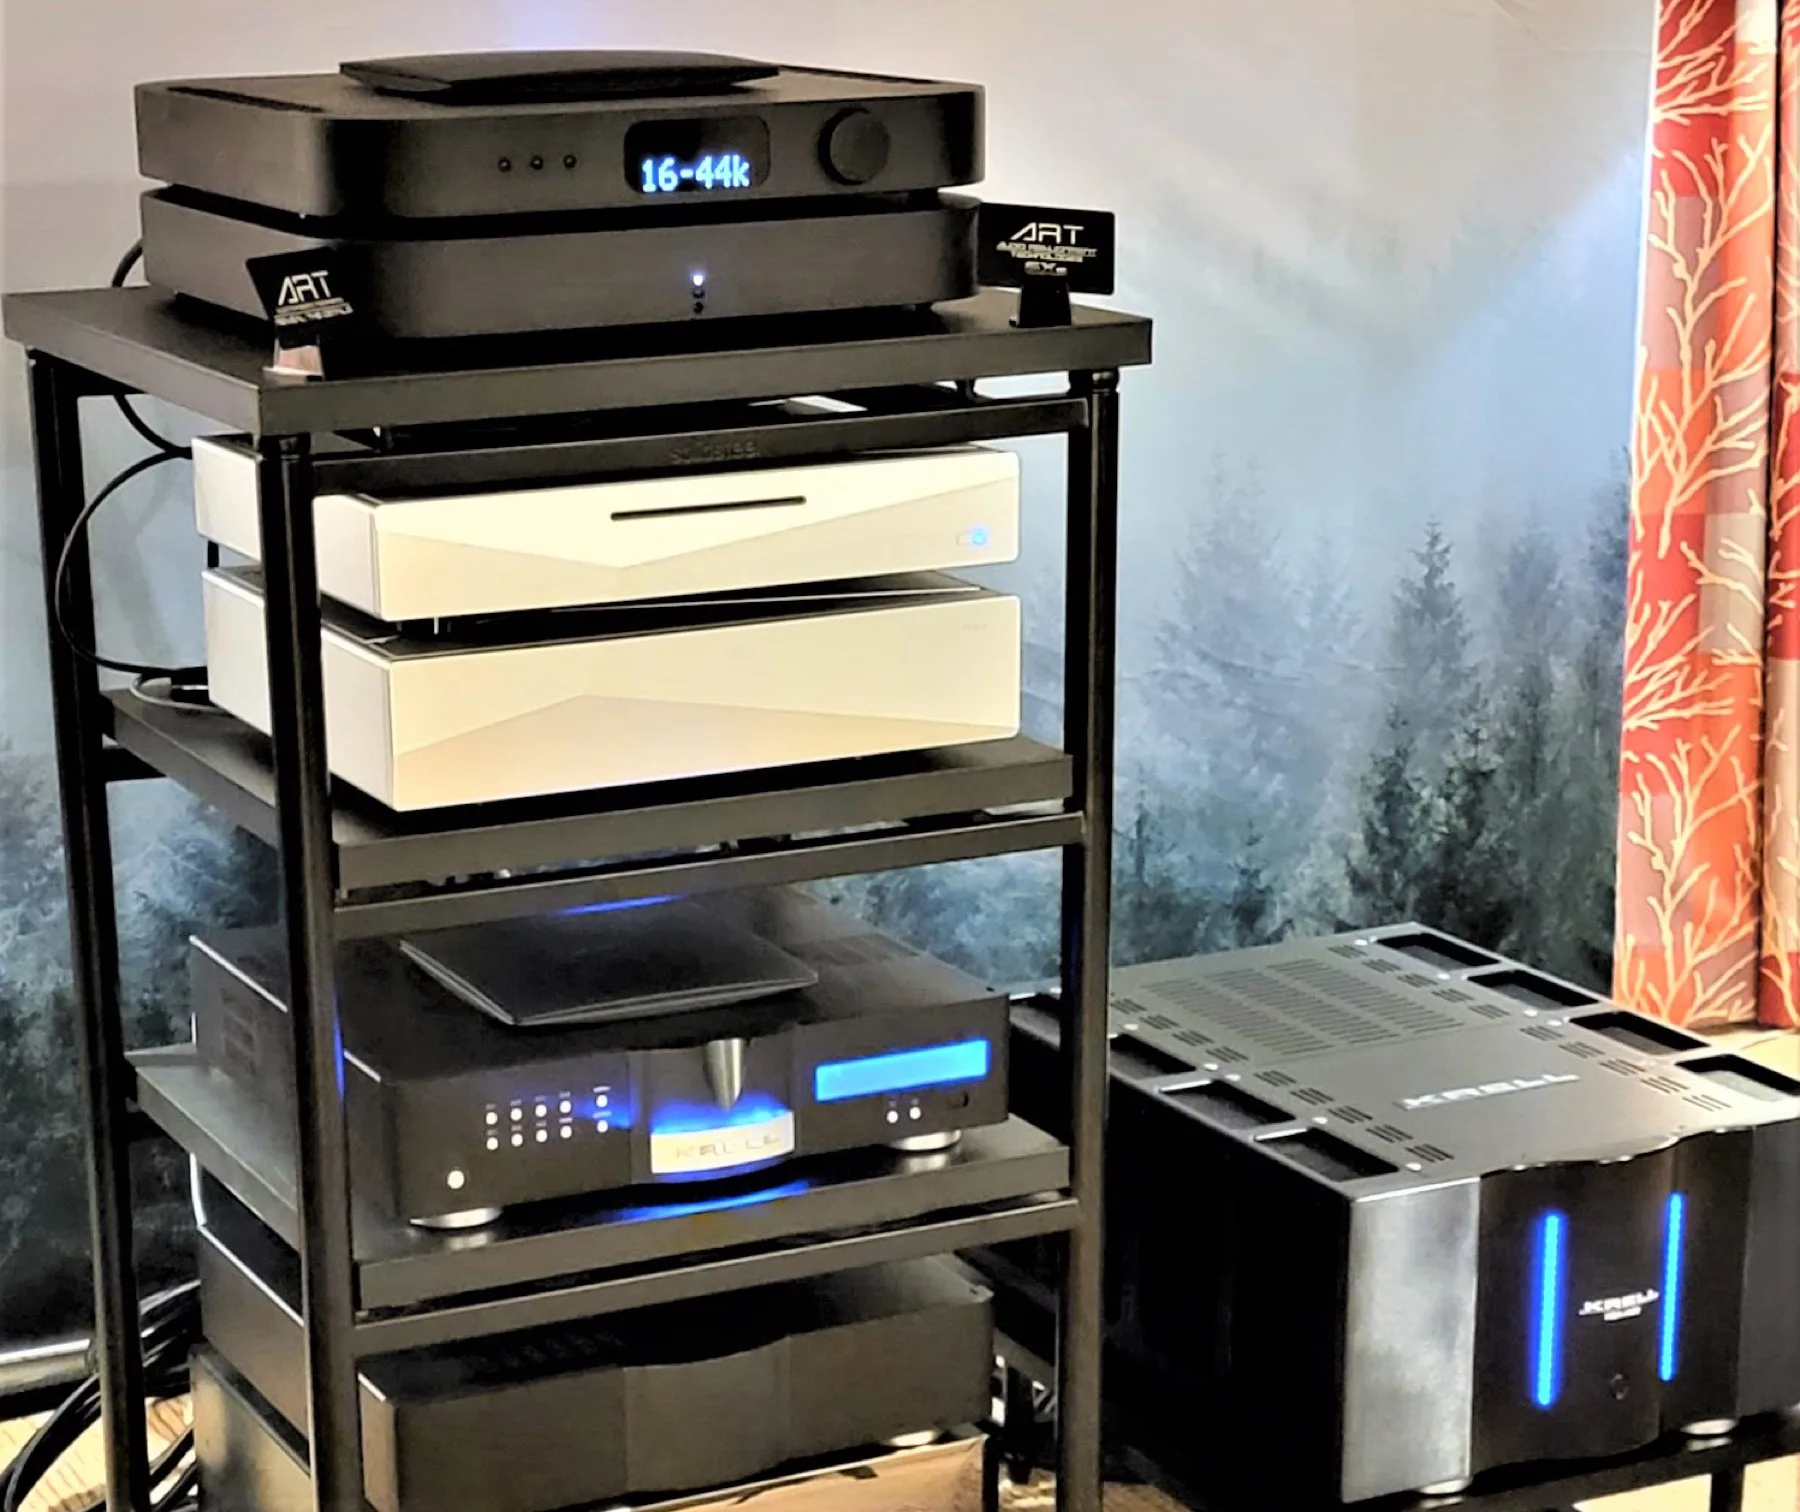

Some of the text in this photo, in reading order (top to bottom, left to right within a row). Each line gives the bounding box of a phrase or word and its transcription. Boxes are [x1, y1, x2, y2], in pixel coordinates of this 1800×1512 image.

[641, 154, 751, 193] 16-44k
[1009, 221, 1085, 245] ART
[277, 269, 331, 306] ART
